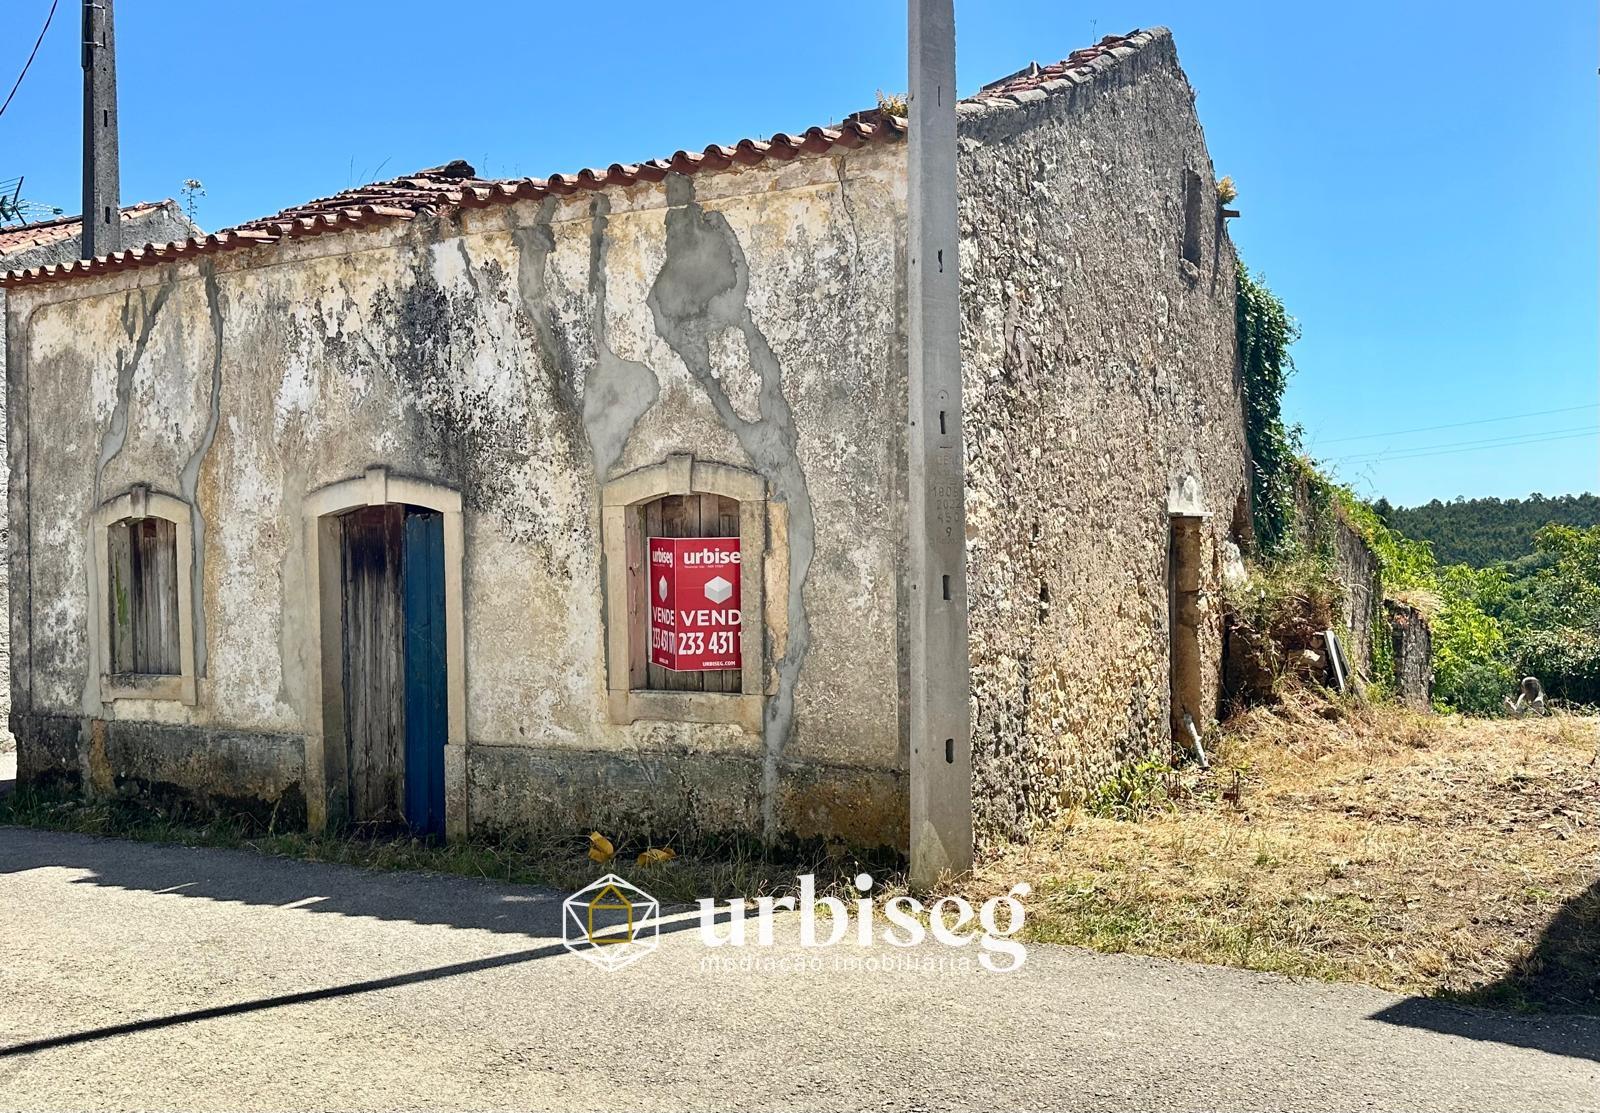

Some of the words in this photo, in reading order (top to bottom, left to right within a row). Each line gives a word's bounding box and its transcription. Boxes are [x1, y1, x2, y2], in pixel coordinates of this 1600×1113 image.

[652, 547, 674, 568] urbiseg
[652, 606, 675, 626] VENDE
[680, 609, 741, 626] VEND
[678, 632, 704, 655] 233
[708, 631, 734, 654] 431
